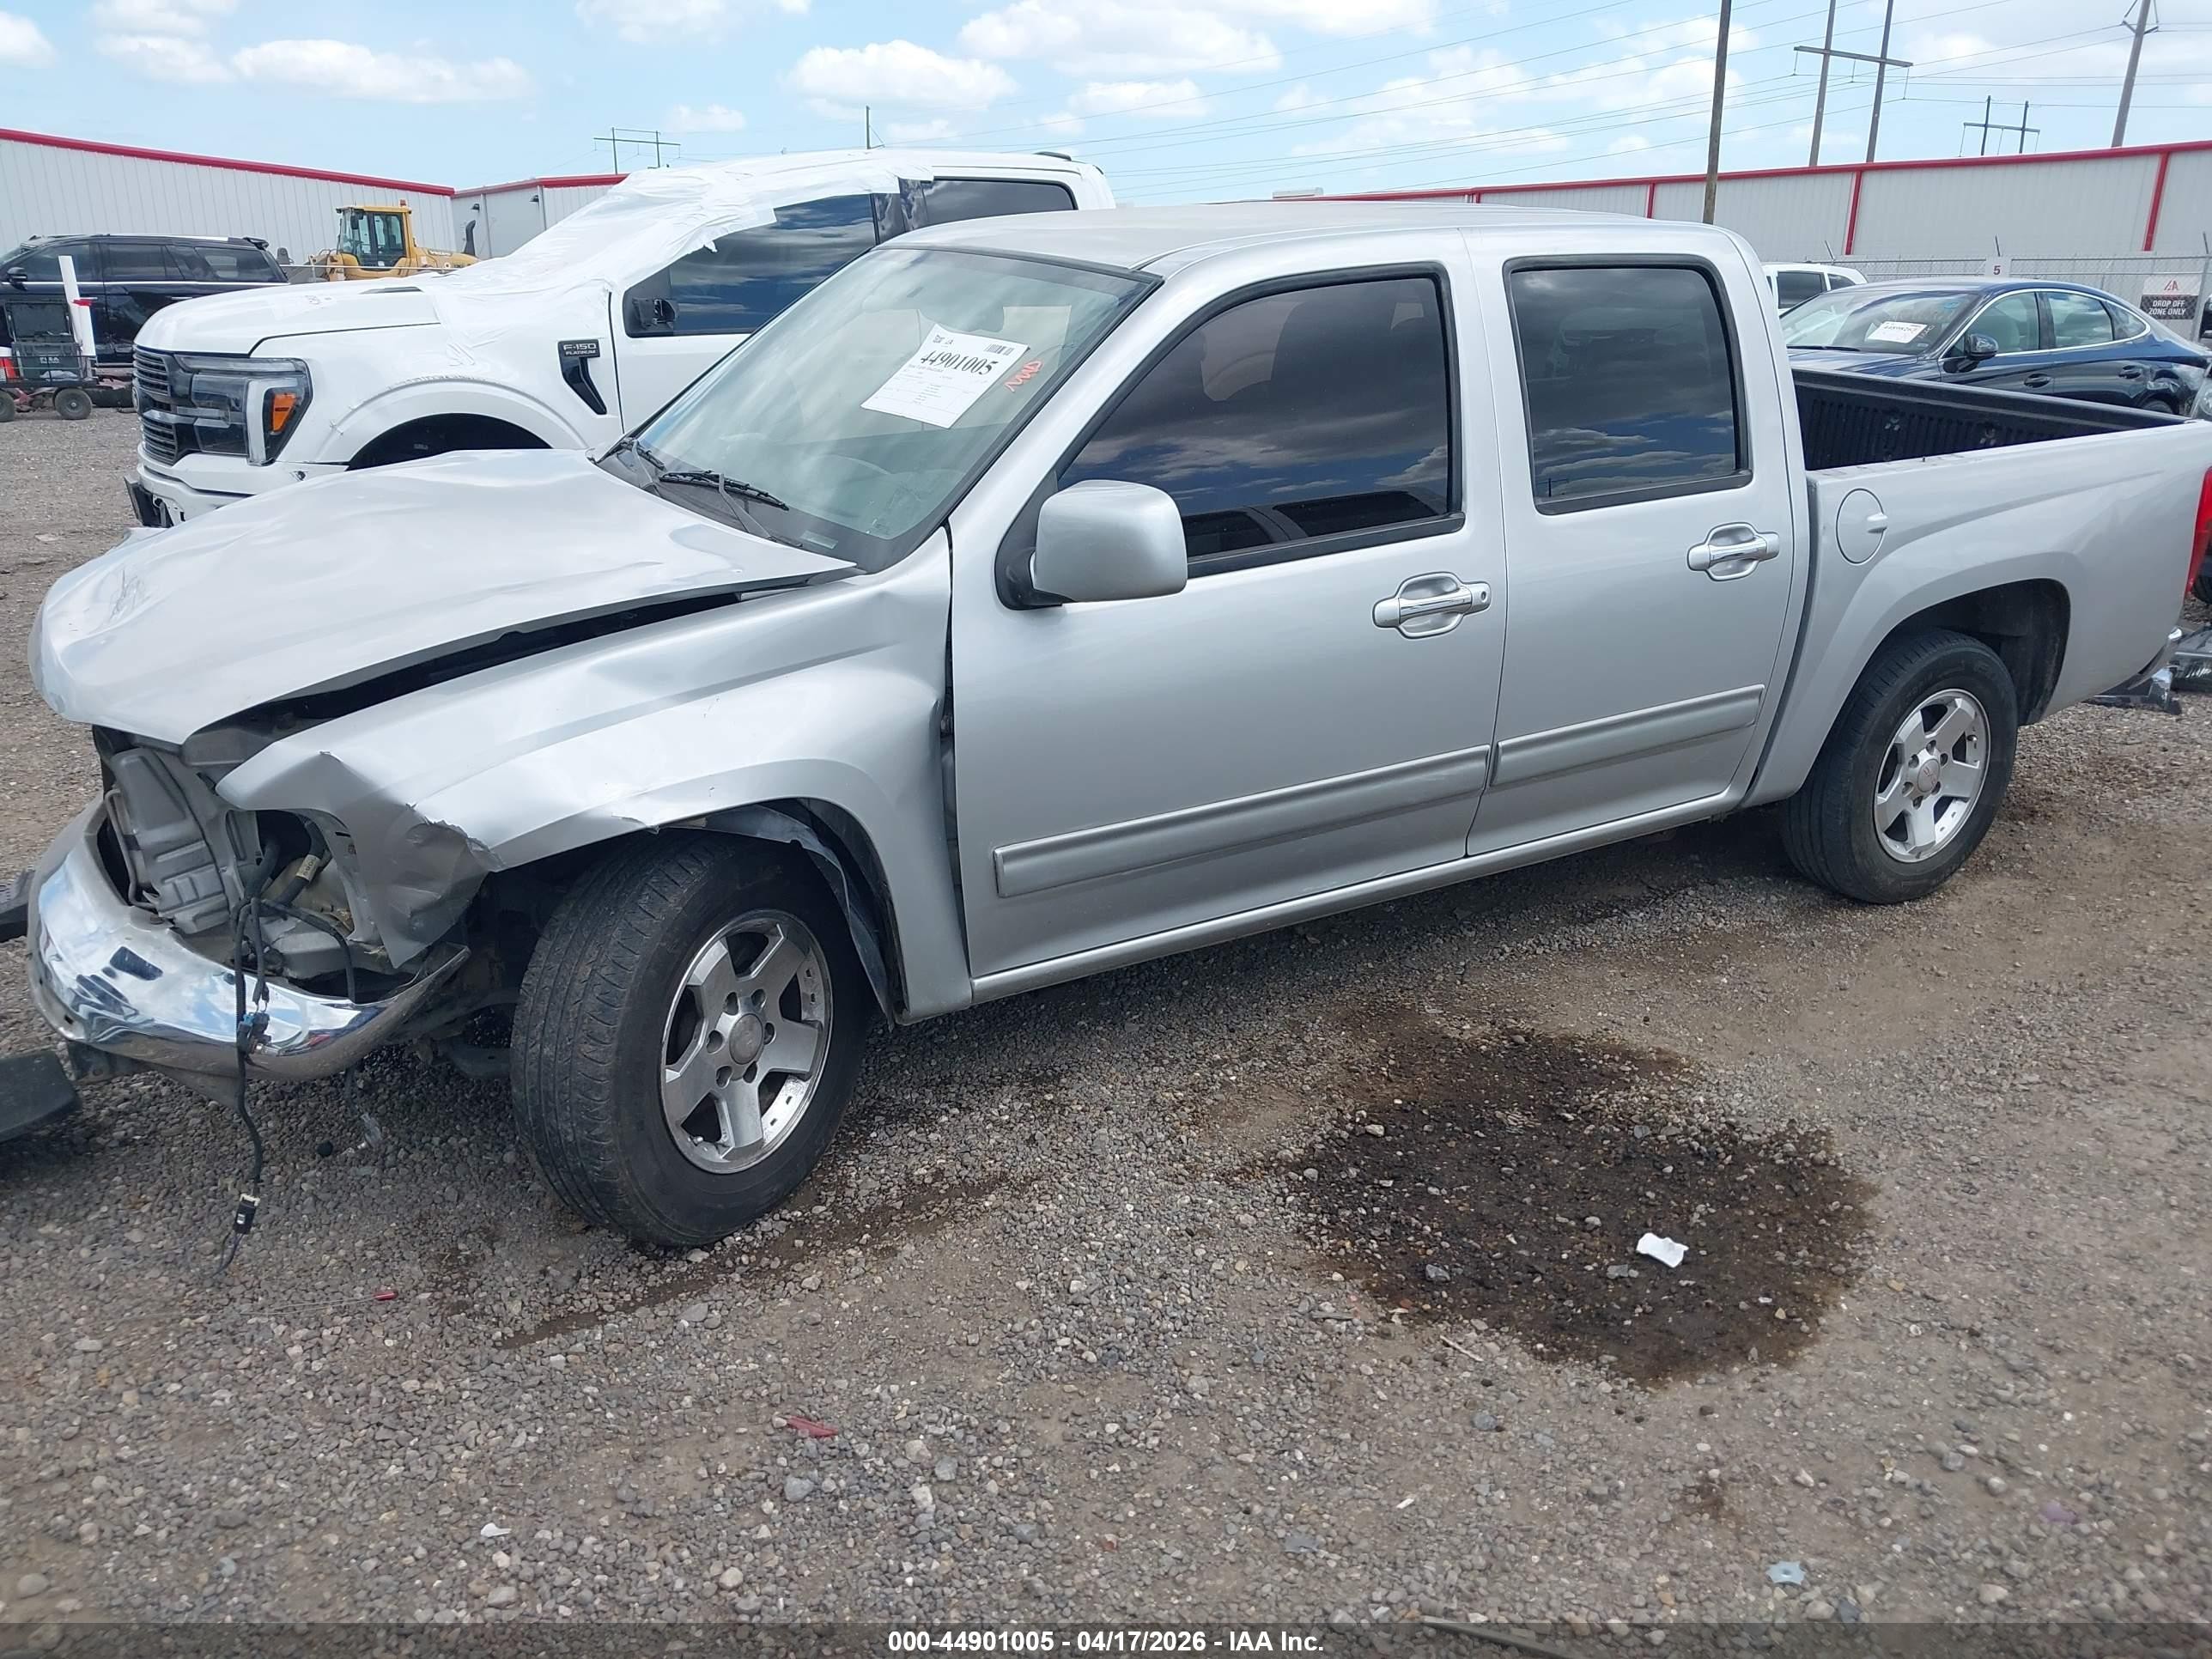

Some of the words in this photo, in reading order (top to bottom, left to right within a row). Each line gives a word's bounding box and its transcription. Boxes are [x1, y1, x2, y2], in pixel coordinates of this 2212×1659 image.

[1993, 265, 2002, 275] 5
[2167, 307, 2186, 316] ONLY
[920, 349, 1000, 375] 44901005
